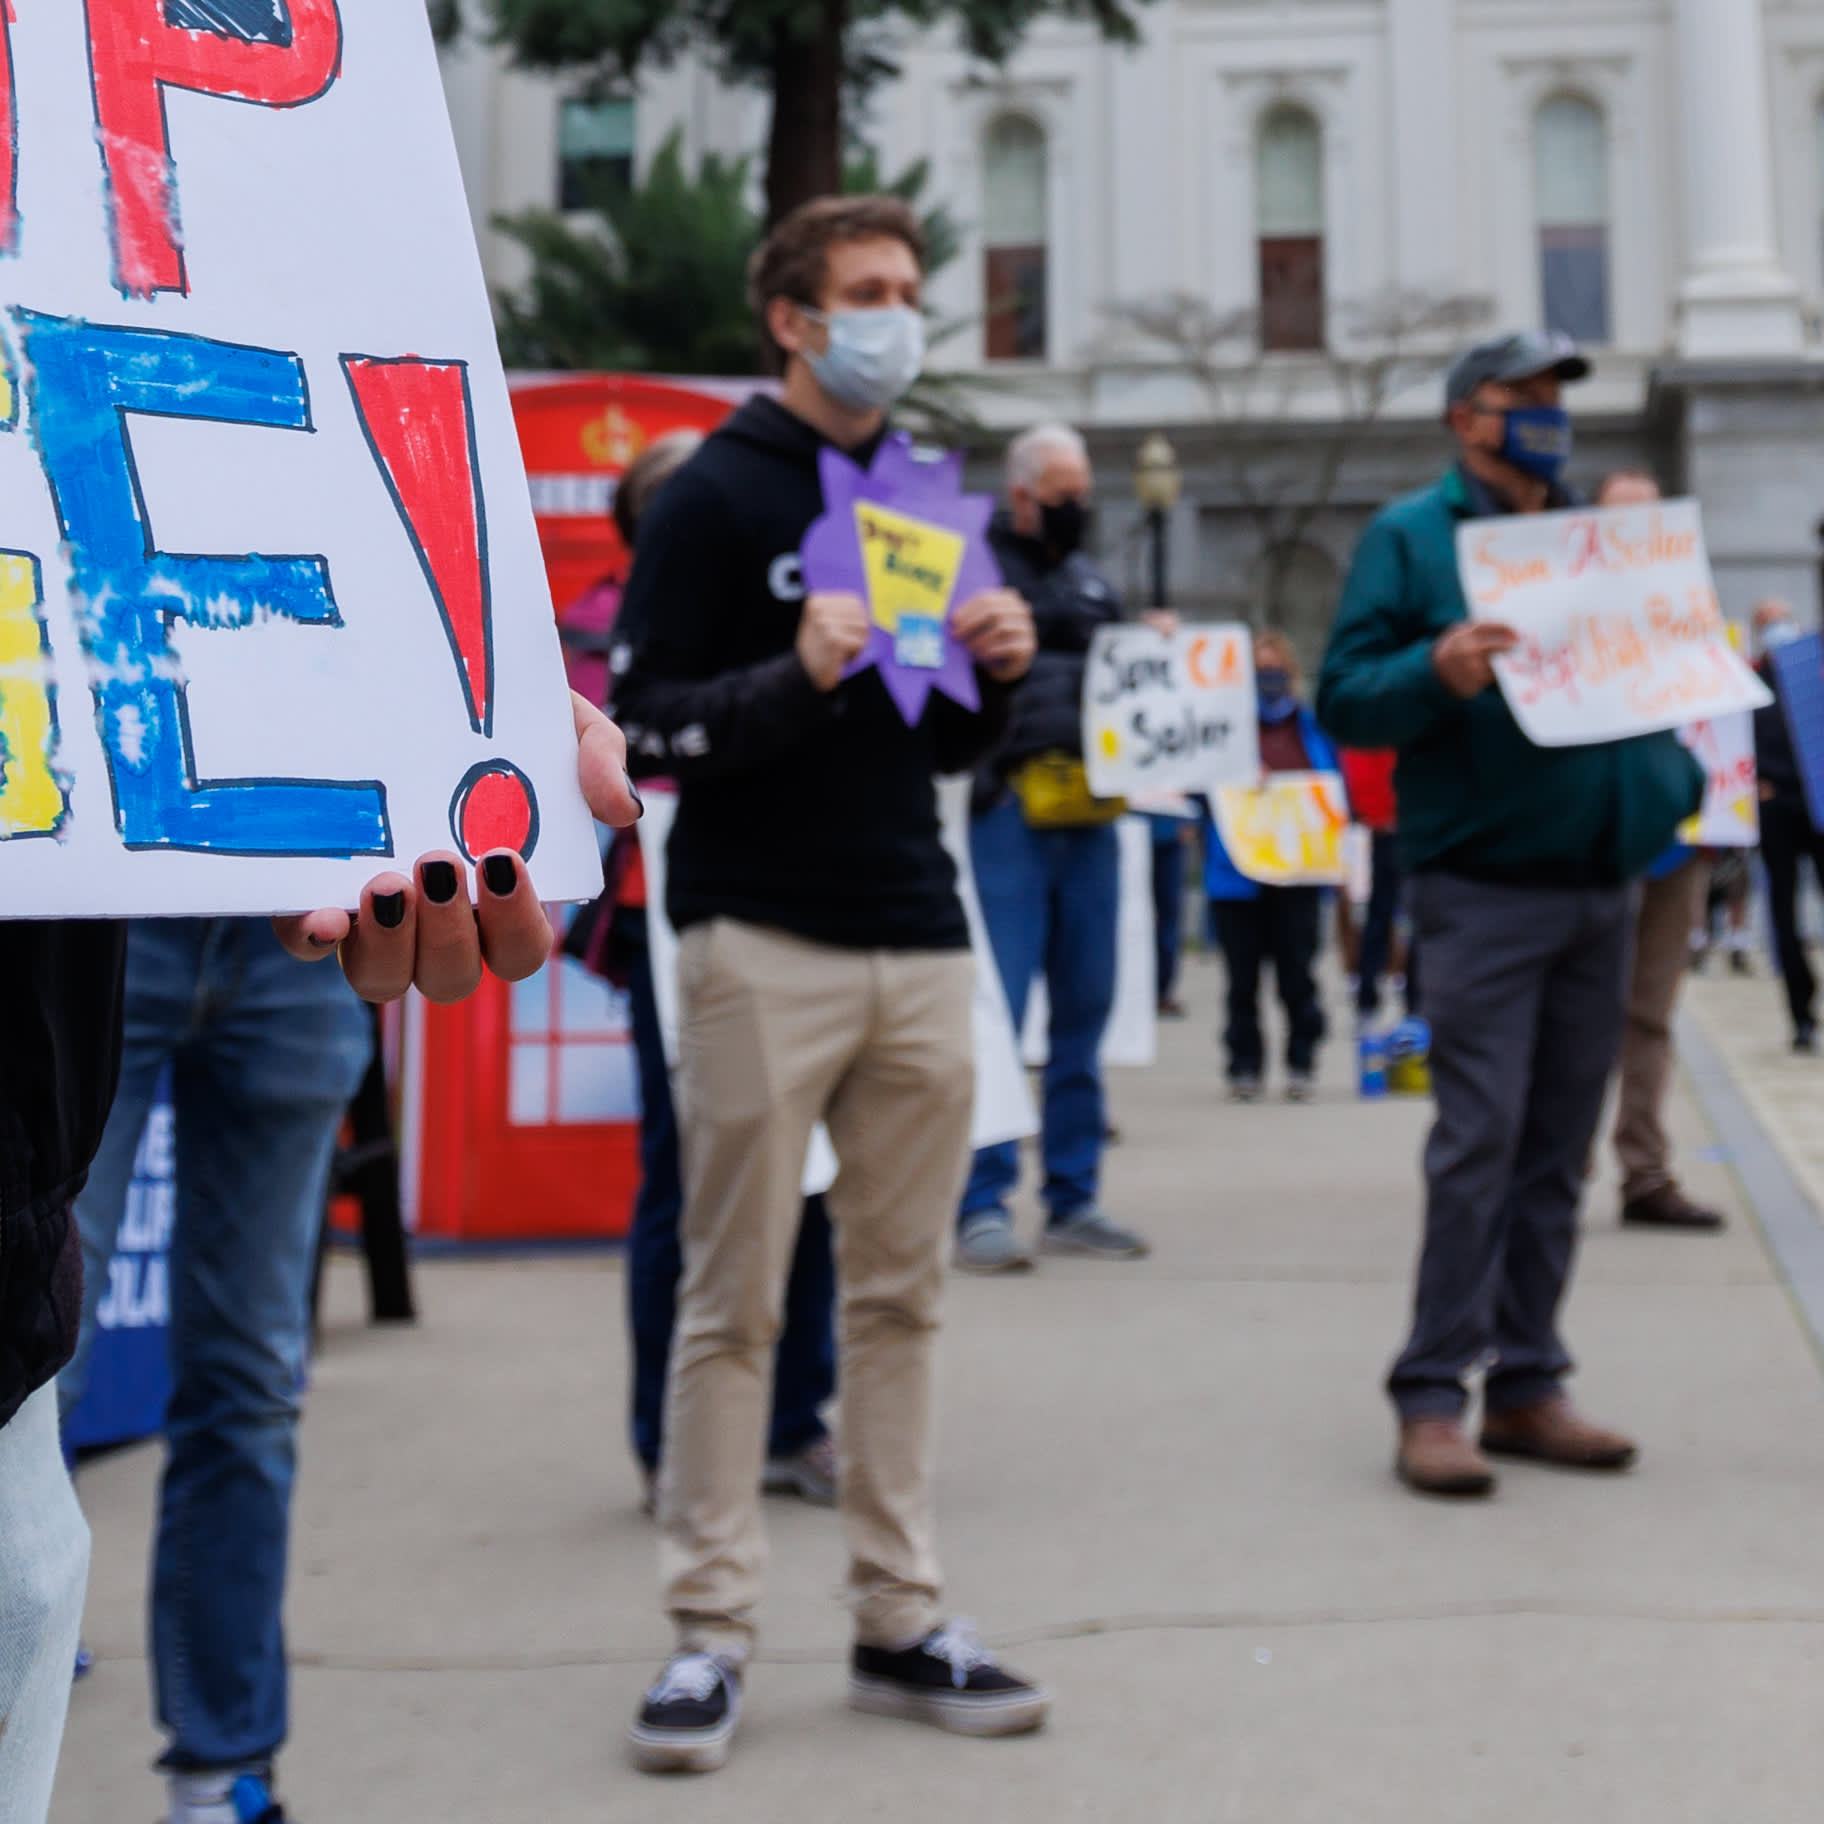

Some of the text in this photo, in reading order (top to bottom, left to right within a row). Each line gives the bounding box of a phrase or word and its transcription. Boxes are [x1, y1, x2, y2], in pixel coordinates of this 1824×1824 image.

[1096, 635, 1243, 703] Save CA
[1130, 706, 1232, 768] Solar
